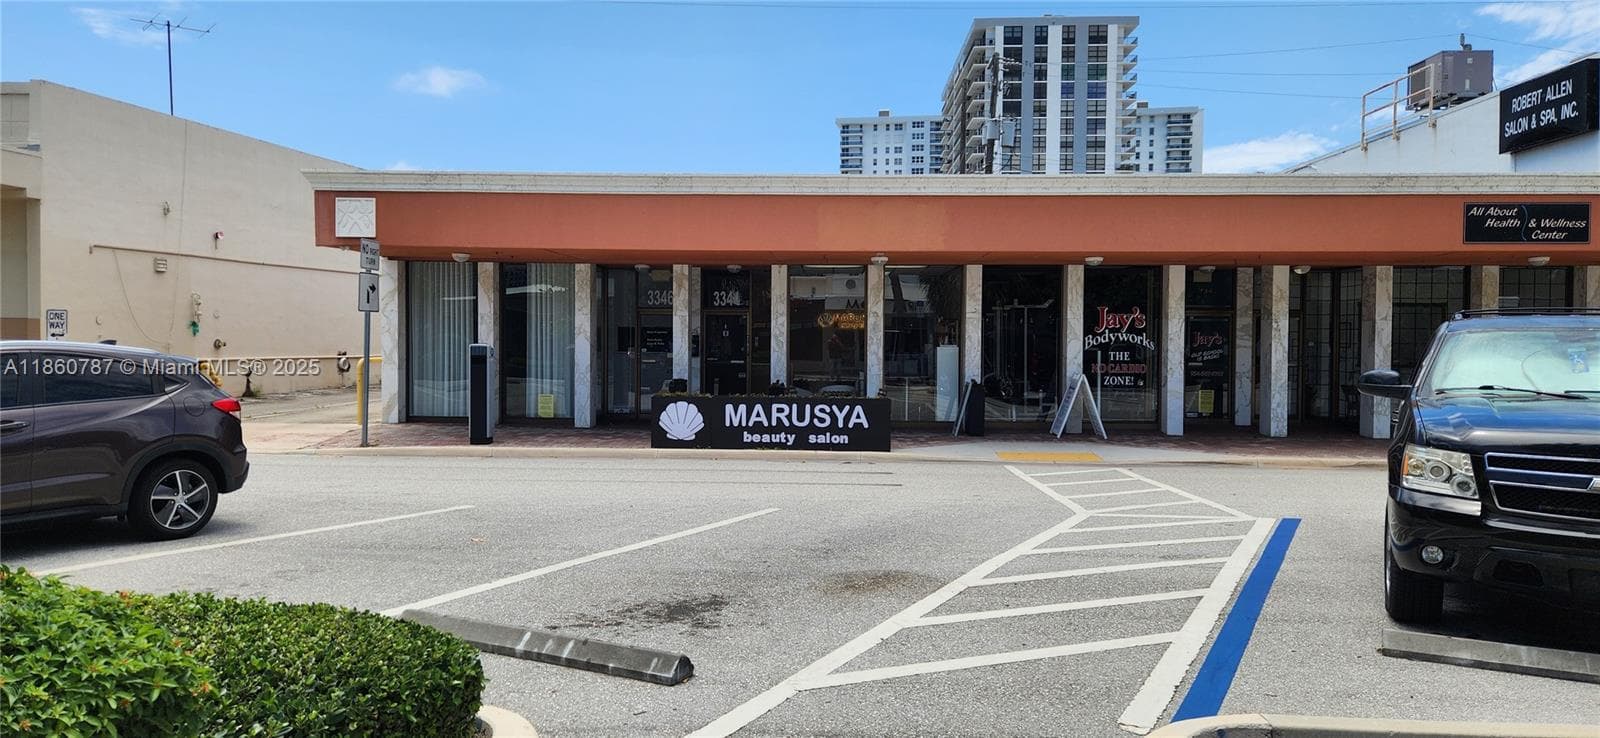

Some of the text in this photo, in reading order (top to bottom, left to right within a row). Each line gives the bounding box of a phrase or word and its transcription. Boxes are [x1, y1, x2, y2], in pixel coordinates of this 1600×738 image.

[1511, 79, 1573, 113] ROBERT ALLEN
[1504, 101, 1579, 138] SALON & SPA, INC.
[1468, 206, 1518, 217] All About
[1484, 218, 1587, 228] Health & Wellness
[1531, 230, 1568, 240] Center
[362, 243, 370, 254] NO
[647, 290, 673, 305] 3346
[49, 312, 65, 321] ONE
[1094, 306, 1146, 333] Jay's
[49, 321, 65, 329] WAY
[1084, 329, 1155, 351] Bodyworks
[1109, 352, 1130, 361] THE
[1108, 363, 1146, 374] CARDIO
[1104, 376, 1134, 386] ZONE!
[724, 403, 869, 428] MARUSYA
[743, 431, 849, 445] beauty salon
